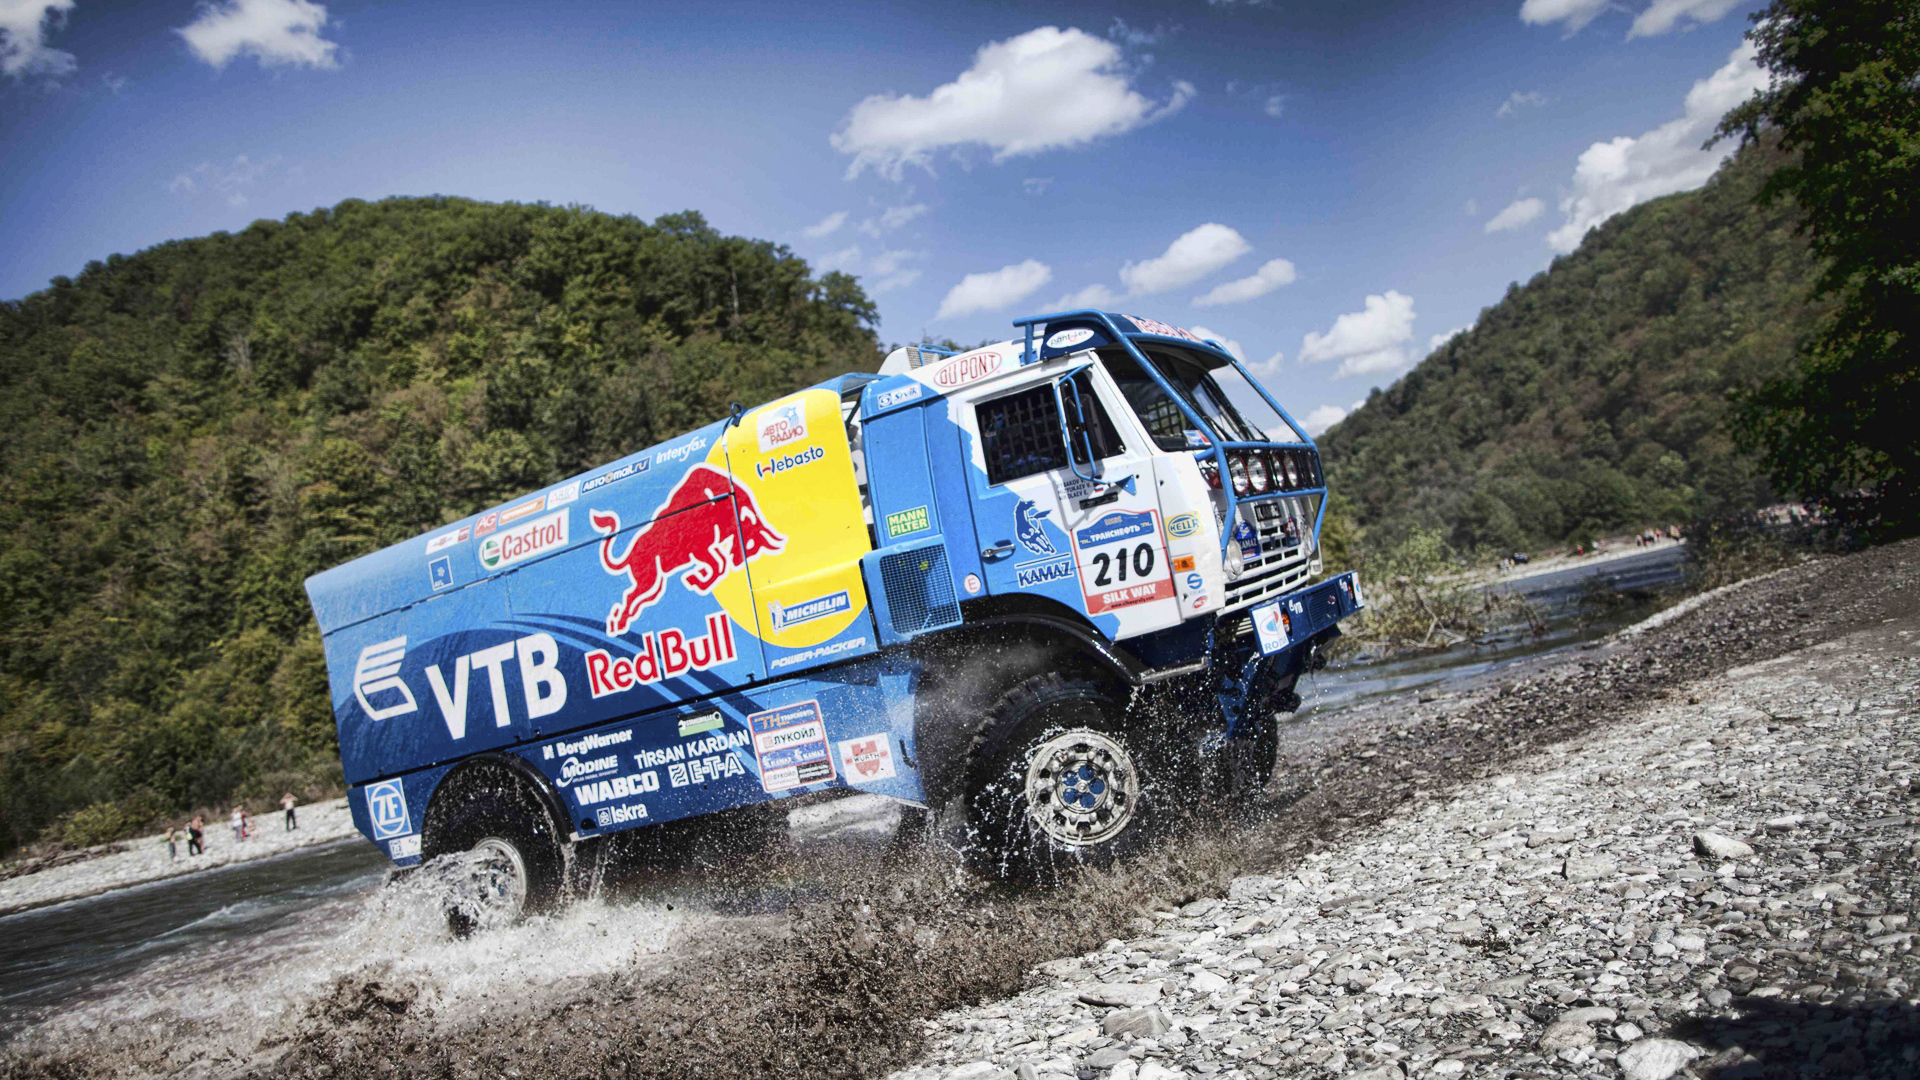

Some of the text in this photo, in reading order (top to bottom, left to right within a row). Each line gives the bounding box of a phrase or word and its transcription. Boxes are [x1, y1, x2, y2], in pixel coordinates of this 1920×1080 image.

[762, 420, 788, 438] АВТО
[770, 425, 804, 445] РАДИО
[756, 446, 824, 478] Webasto
[889, 508, 926, 525] MANN
[891, 519, 927, 536] FILTER
[502, 517, 563, 560] Castrol
[1090, 525, 1141, 542] ТРАНСНЕФТЬ
[1018, 562, 1073, 587] KAMAZ
[1092, 542, 1155, 587] 210
[1102, 584, 1157, 605] SILK WAY
[786, 595, 846, 621] MICHELIN
[771, 637, 866, 669] POWER-PACKER
[424, 632, 567, 740] VTB
[558, 729, 632, 757] BorgWarner
[686, 729, 750, 757] KARDAN
[774, 728, 816, 745] ЛУКОЙЛ
[563, 754, 618, 779] MODINE
[574, 771, 660, 805] WABCO
[372, 792, 404, 826] ZF
[611, 803, 648, 823] Iskra
